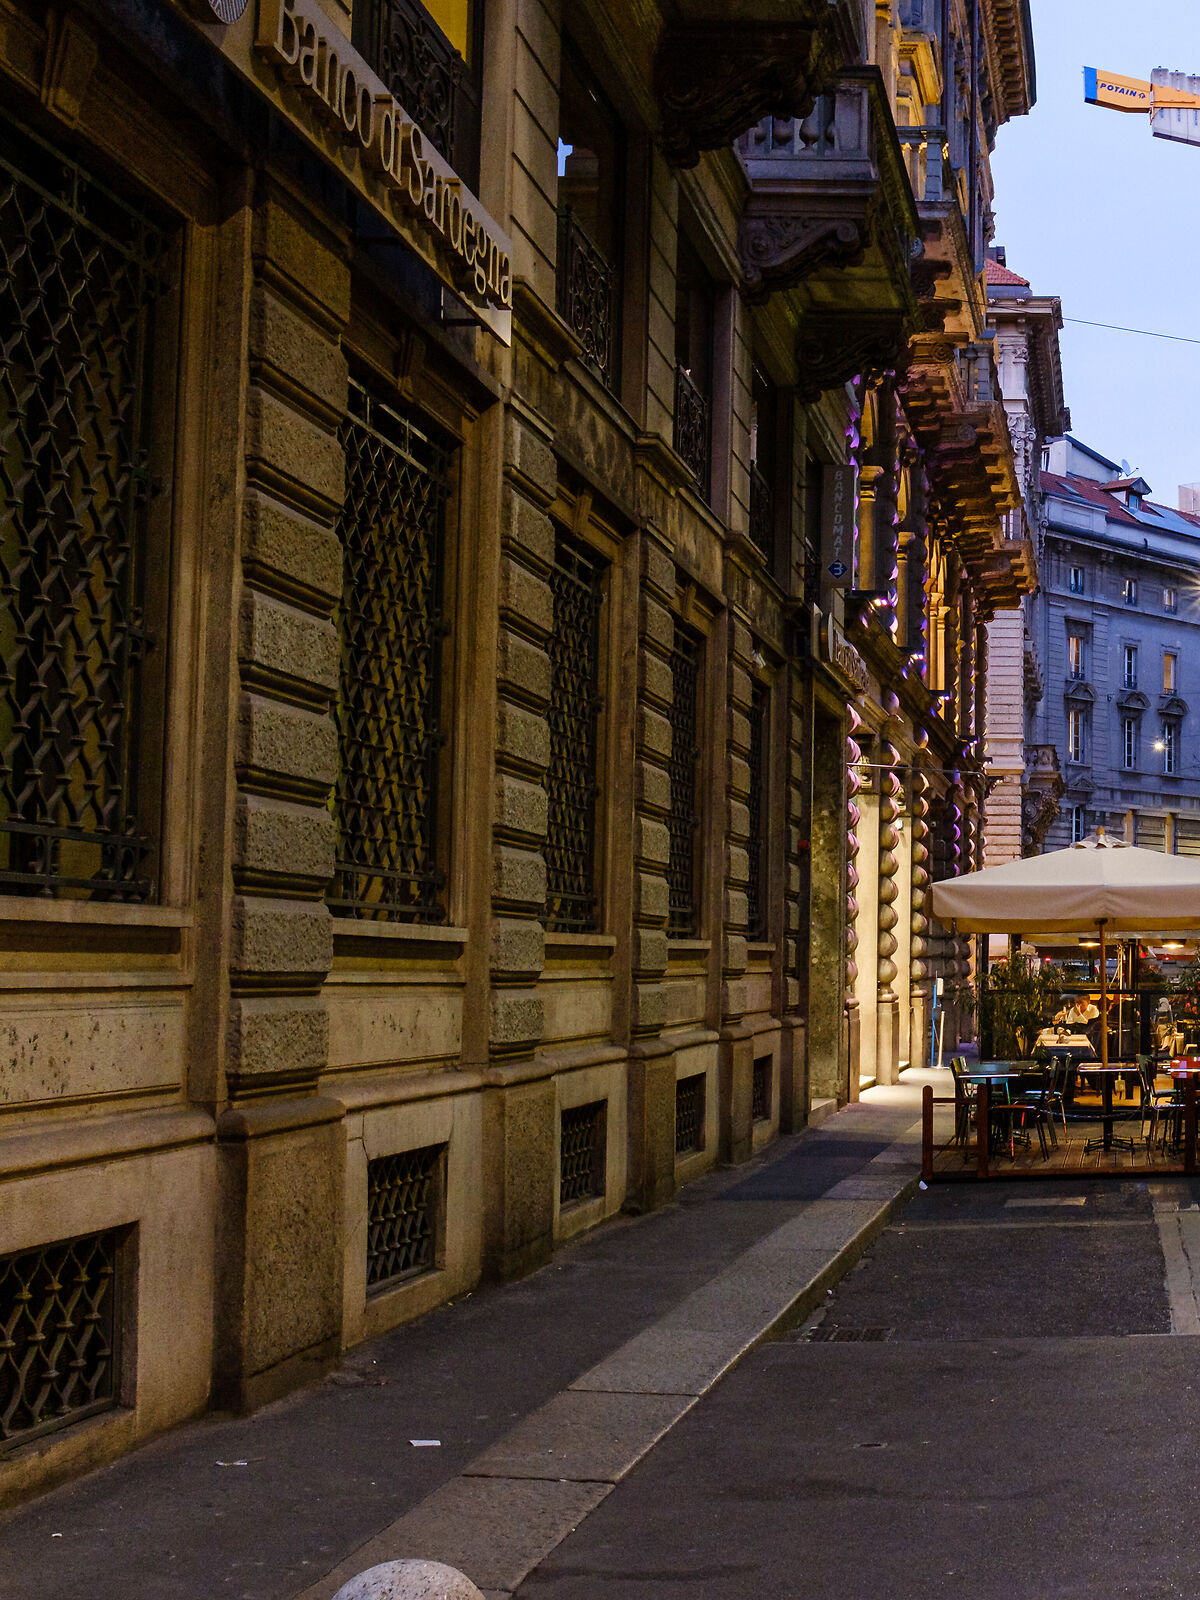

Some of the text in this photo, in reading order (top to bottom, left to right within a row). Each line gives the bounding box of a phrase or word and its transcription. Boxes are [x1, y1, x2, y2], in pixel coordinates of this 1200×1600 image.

[1100, 82, 1137, 98] POTAIN
[270, 0, 513, 310] Banco di Sardegna
[833, 470, 844, 558] BANCOMAT
